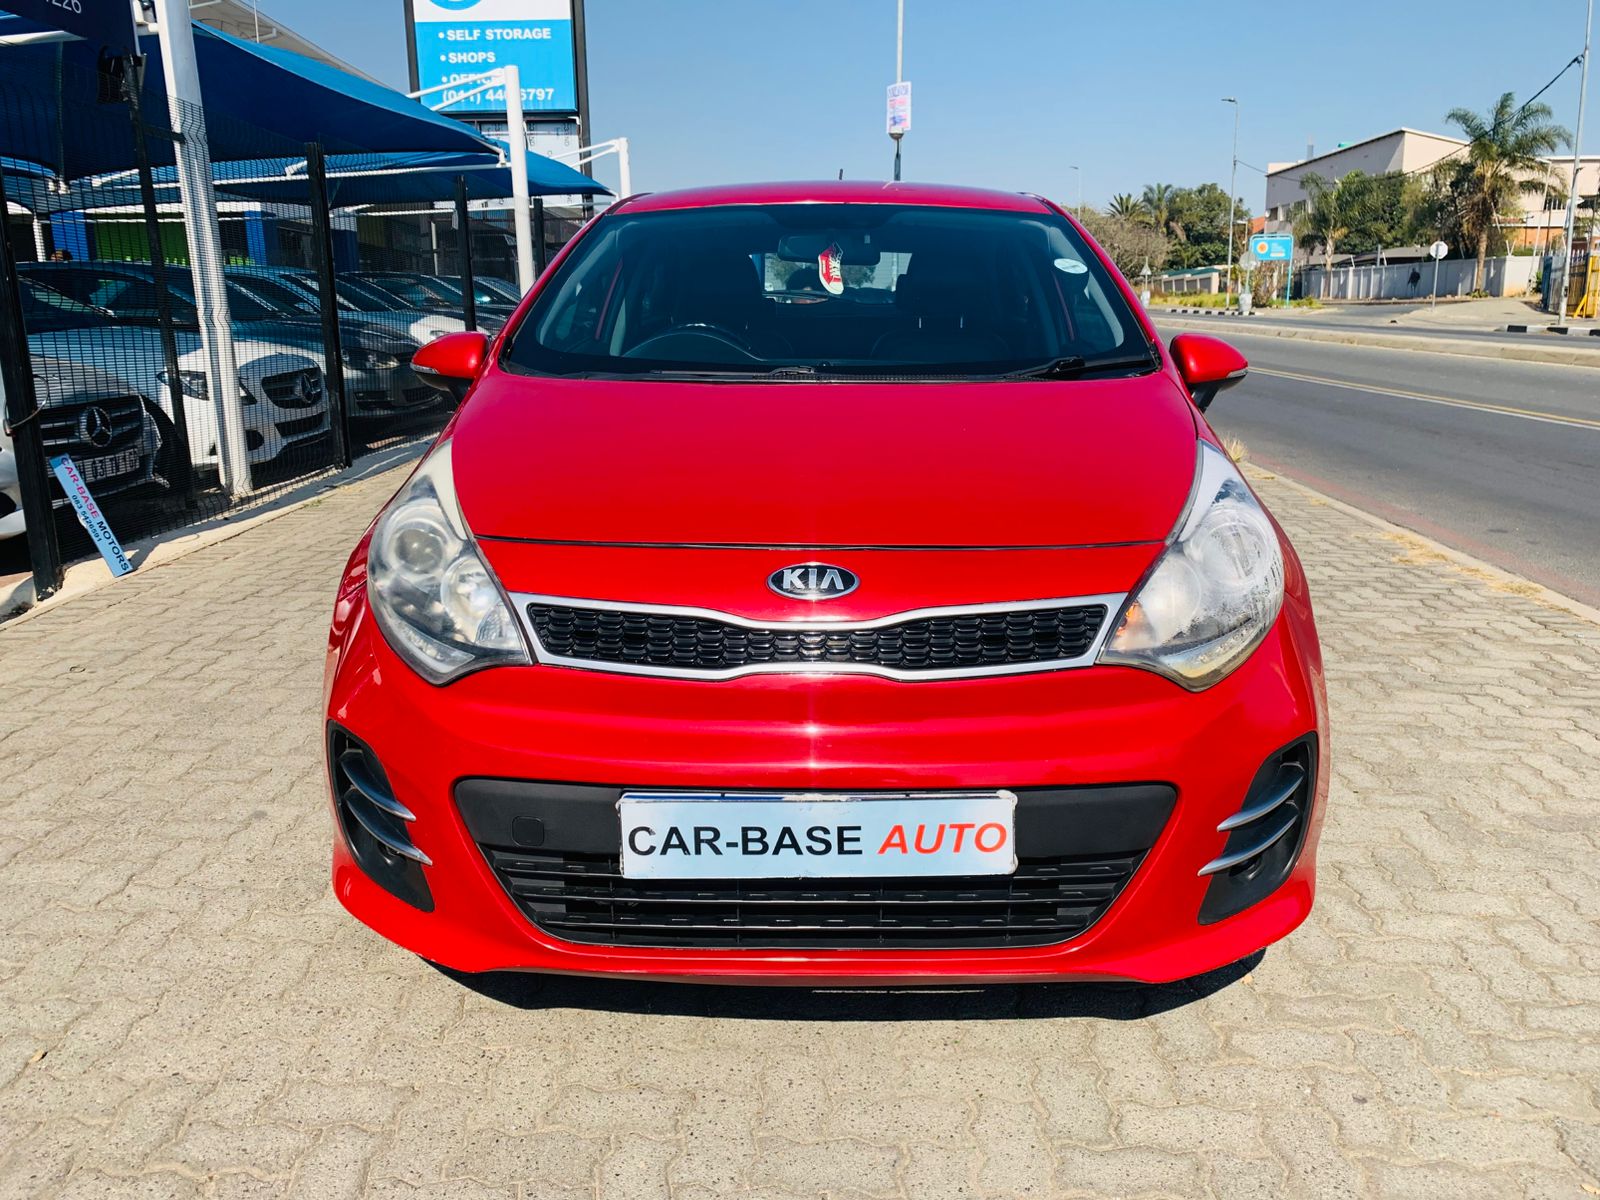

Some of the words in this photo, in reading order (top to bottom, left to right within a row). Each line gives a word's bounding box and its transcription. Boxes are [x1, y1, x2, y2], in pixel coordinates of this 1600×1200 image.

[446, 29, 481, 41] SELF
[485, 27, 552, 40] STORAGE
[448, 51, 496, 64] SHOPS
[71, 494, 83, 510] 083
[61, 456, 100, 519] CAR-BASE
[97, 520, 129, 571] MOTORS
[782, 568, 845, 590] KIA
[627, 825, 863, 856] CAR-BASE
[877, 822, 1008, 855] AUTO
